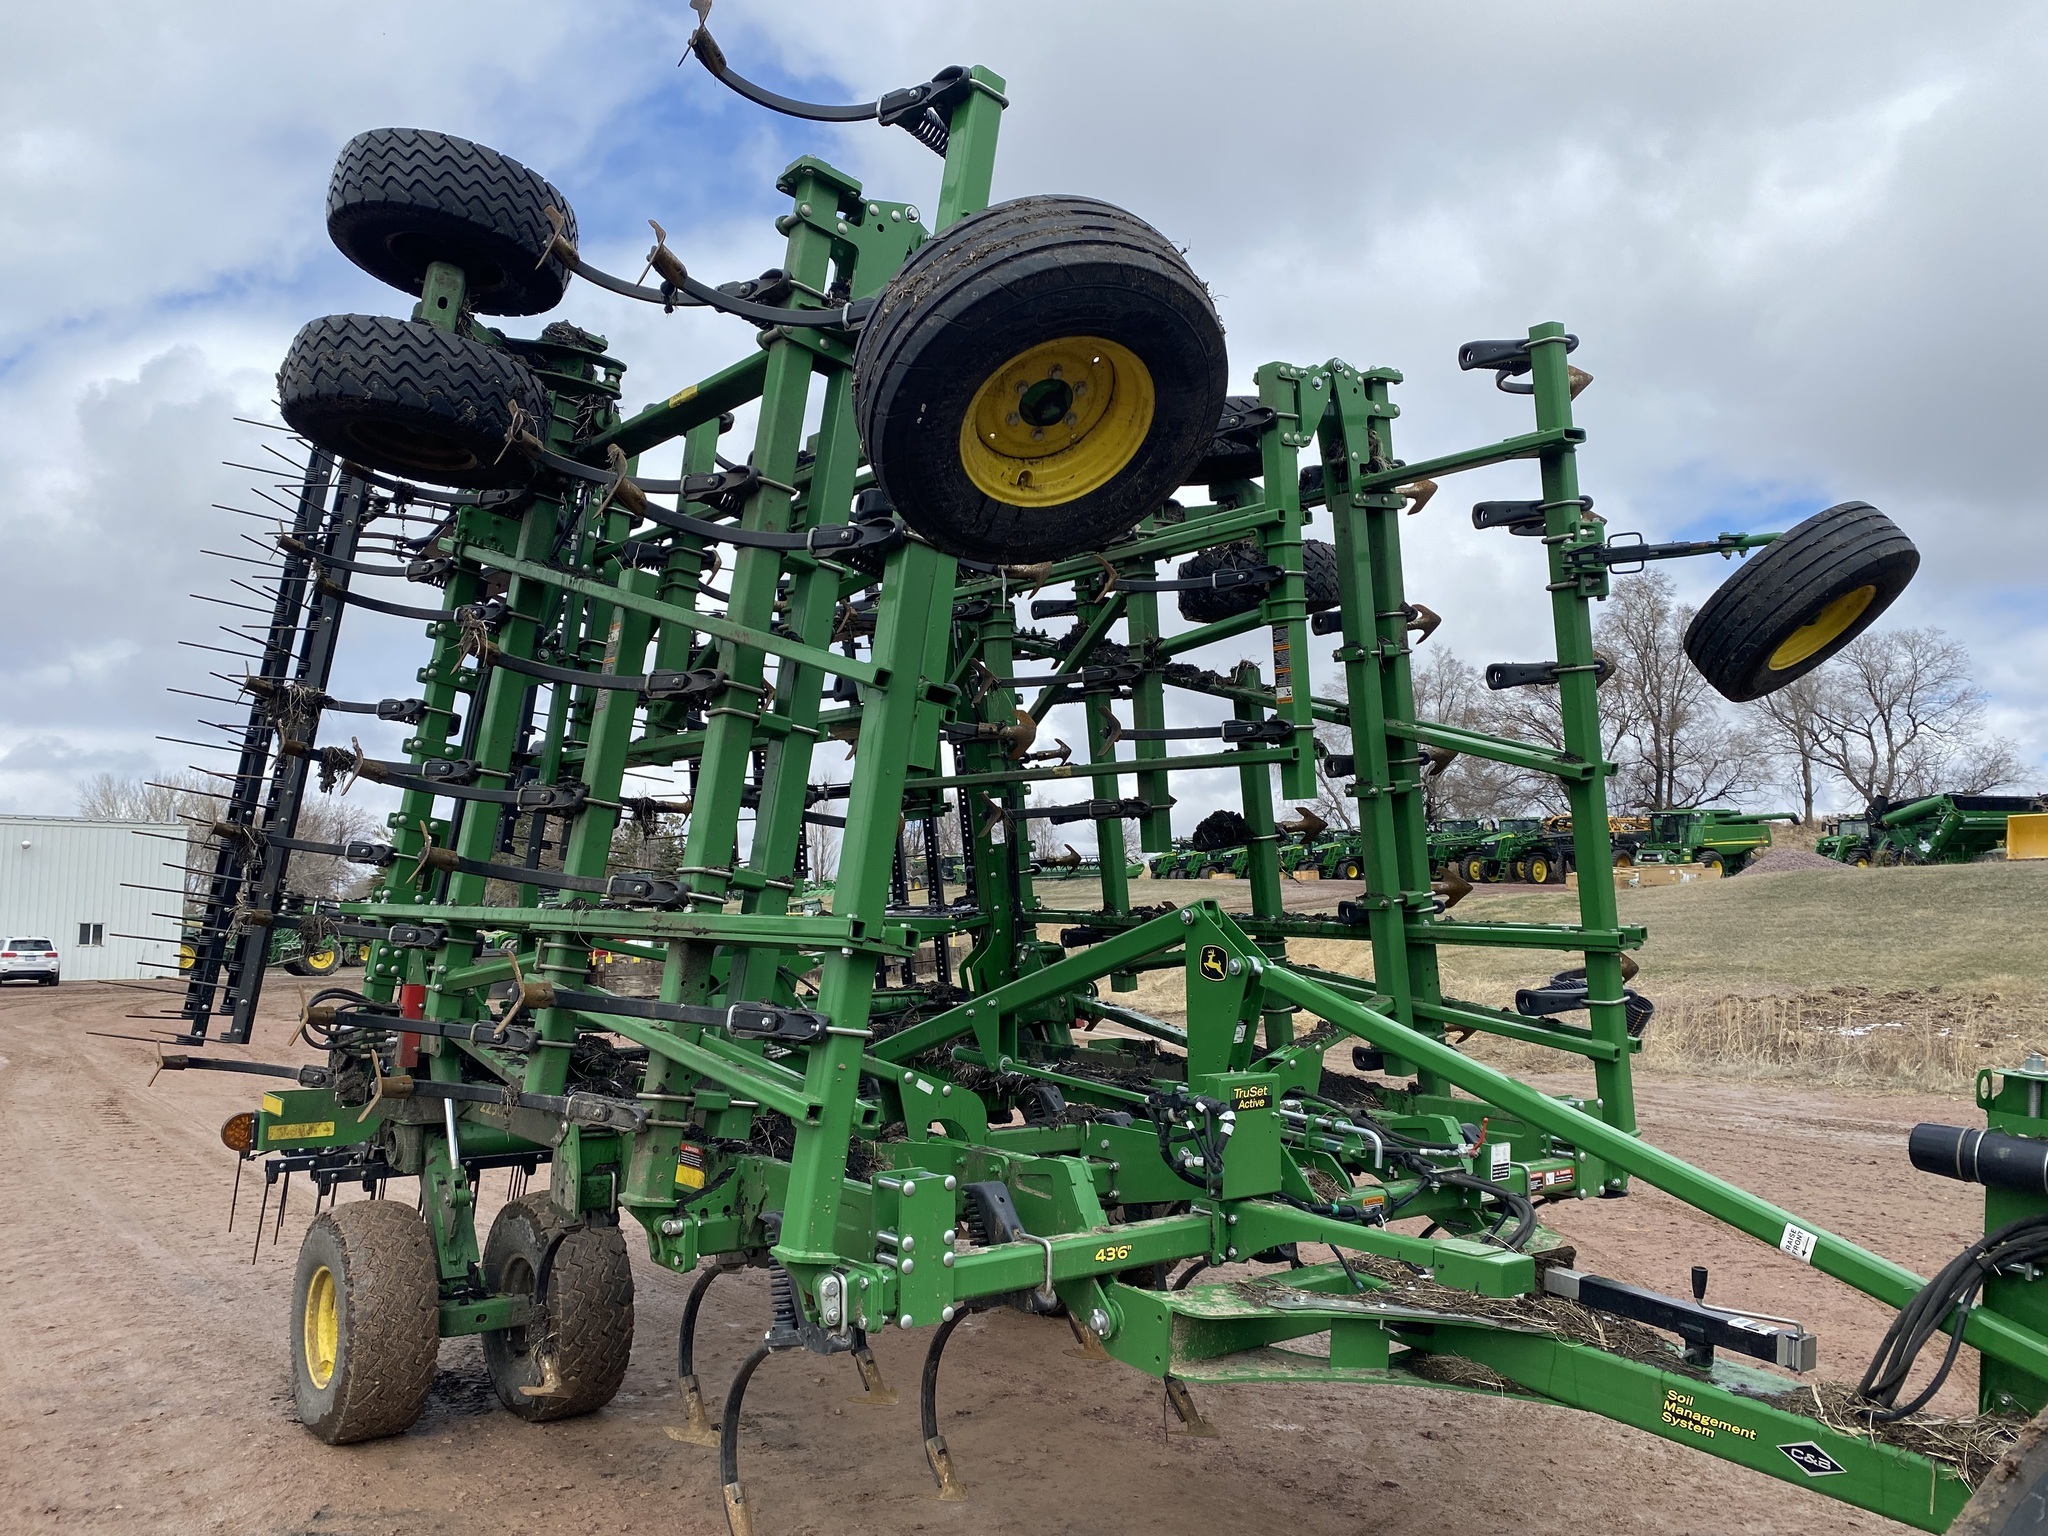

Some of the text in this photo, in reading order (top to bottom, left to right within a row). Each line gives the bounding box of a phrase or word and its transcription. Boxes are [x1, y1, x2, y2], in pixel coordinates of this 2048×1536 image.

[1233, 1085, 1268, 1099] TruSet
[1237, 1098, 1265, 1110] Active
[1785, 1228, 1797, 1251] RAISE
[1792, 1230, 1804, 1256] FRONT
[1094, 1244, 1132, 1263] 43'6"
[1666, 1389, 1695, 1407] Soil
[1661, 1411, 1715, 1438] System
[1663, 1400, 1757, 1441] Management
[1790, 1448, 1832, 1471] C&B
